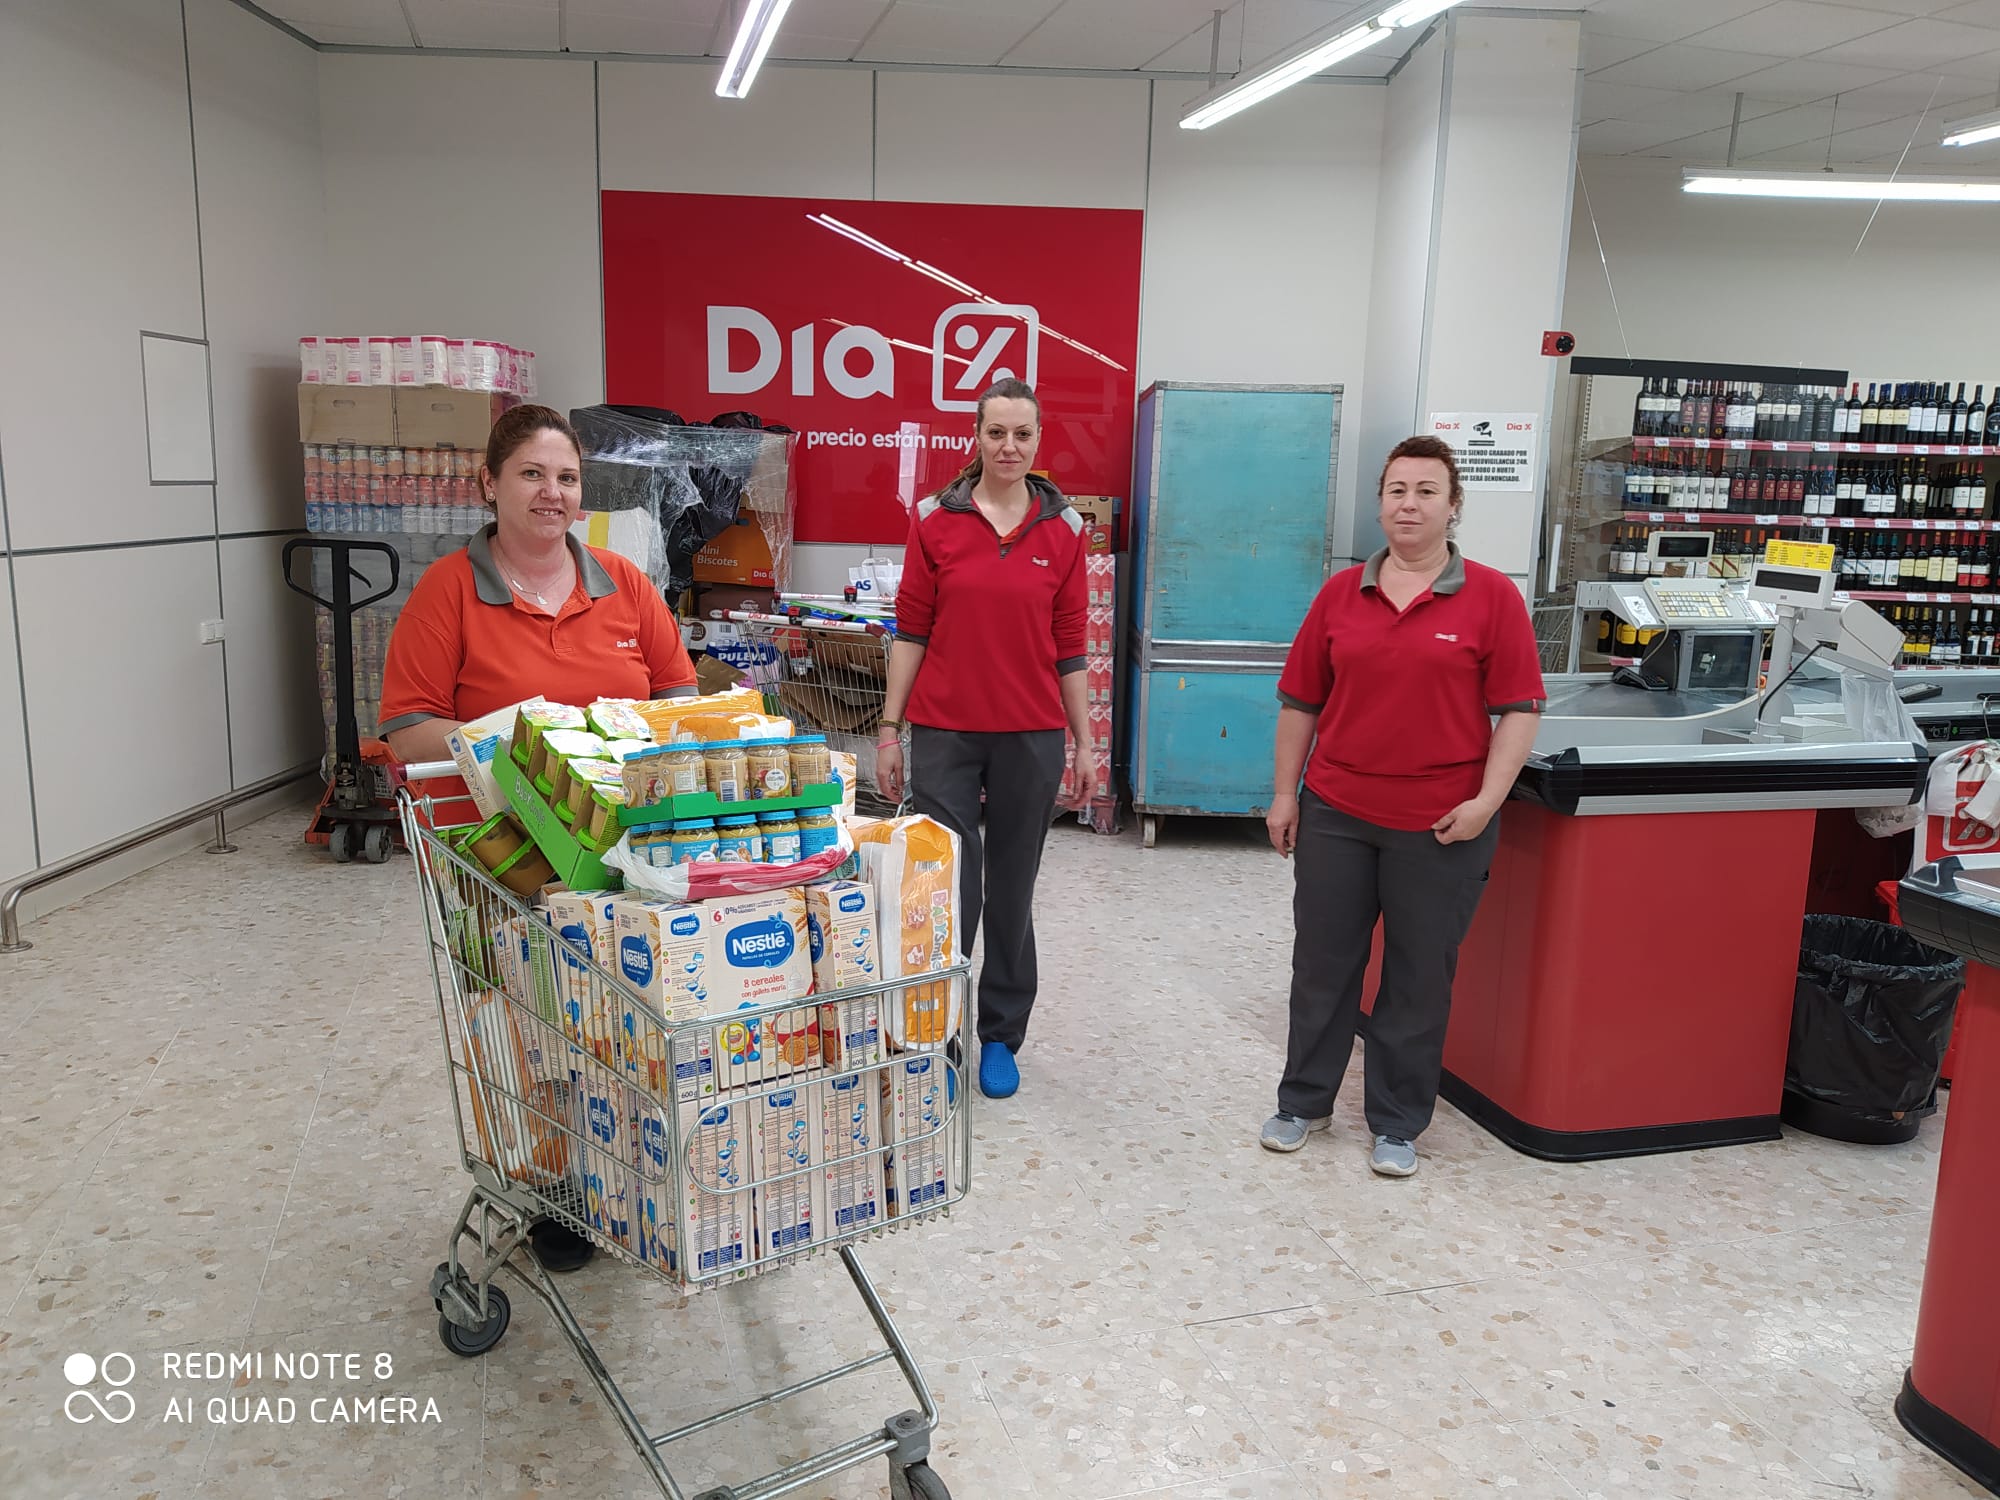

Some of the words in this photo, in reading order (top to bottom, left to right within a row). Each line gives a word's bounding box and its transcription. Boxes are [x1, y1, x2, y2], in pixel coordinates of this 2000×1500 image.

[807, 428, 867, 450] precio
[872, 431, 926, 449] están
[931, 435, 975, 455] muy
[696, 555, 738, 567] Biscotes
[718, 652, 767, 662] PULEVA
[713, 910, 722, 922] 6
[673, 920, 698, 932] Nestlé
[732, 931, 786, 956] Nestlé
[623, 947, 649, 971] Nestlé
[744, 979, 750, 989] 8
[751, 974, 785, 987] cereales
